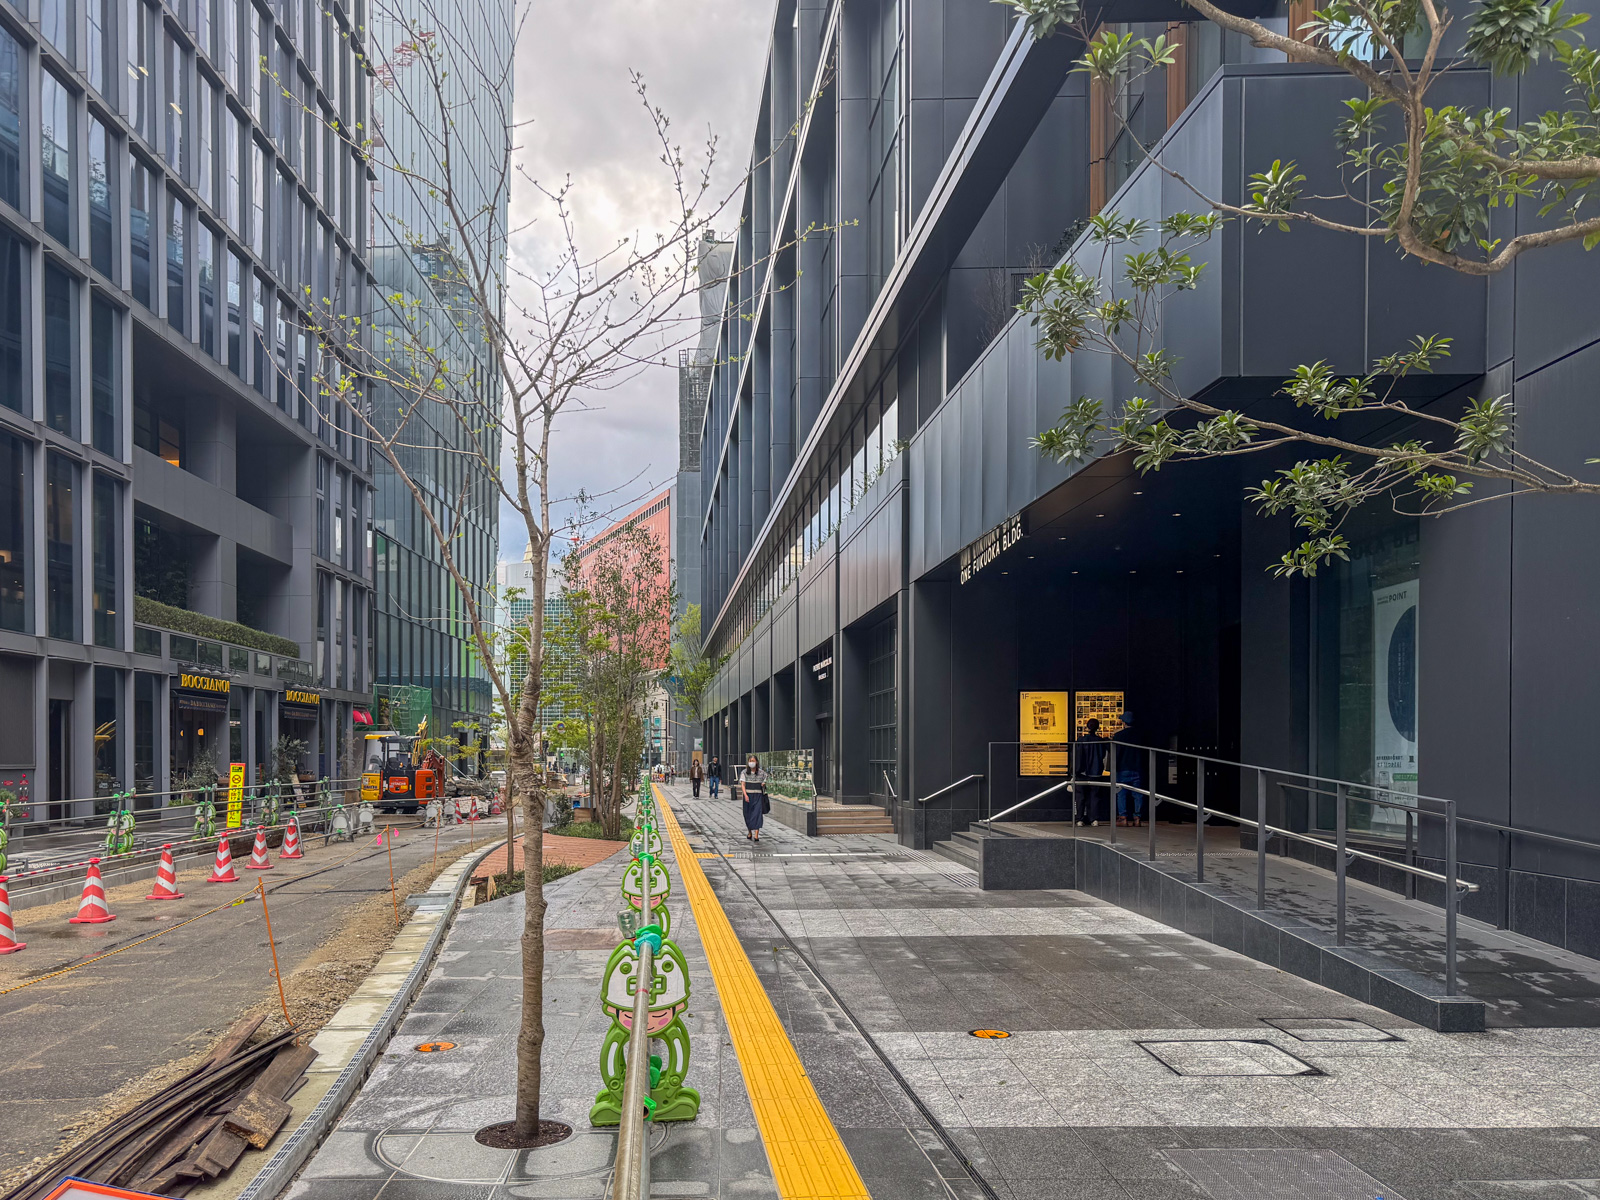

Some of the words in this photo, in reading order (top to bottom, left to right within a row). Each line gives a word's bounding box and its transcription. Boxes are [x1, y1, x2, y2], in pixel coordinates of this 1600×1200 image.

[960, 565, 972, 585] ONE
[972, 541, 1001, 575] FUKUOKA
[1002, 522, 1024, 551] BLDG.
[1389, 591, 1408, 603] POINT
[180, 673, 231, 693] BOCCIANO!
[285, 690, 320, 705] BOCCIANO!
